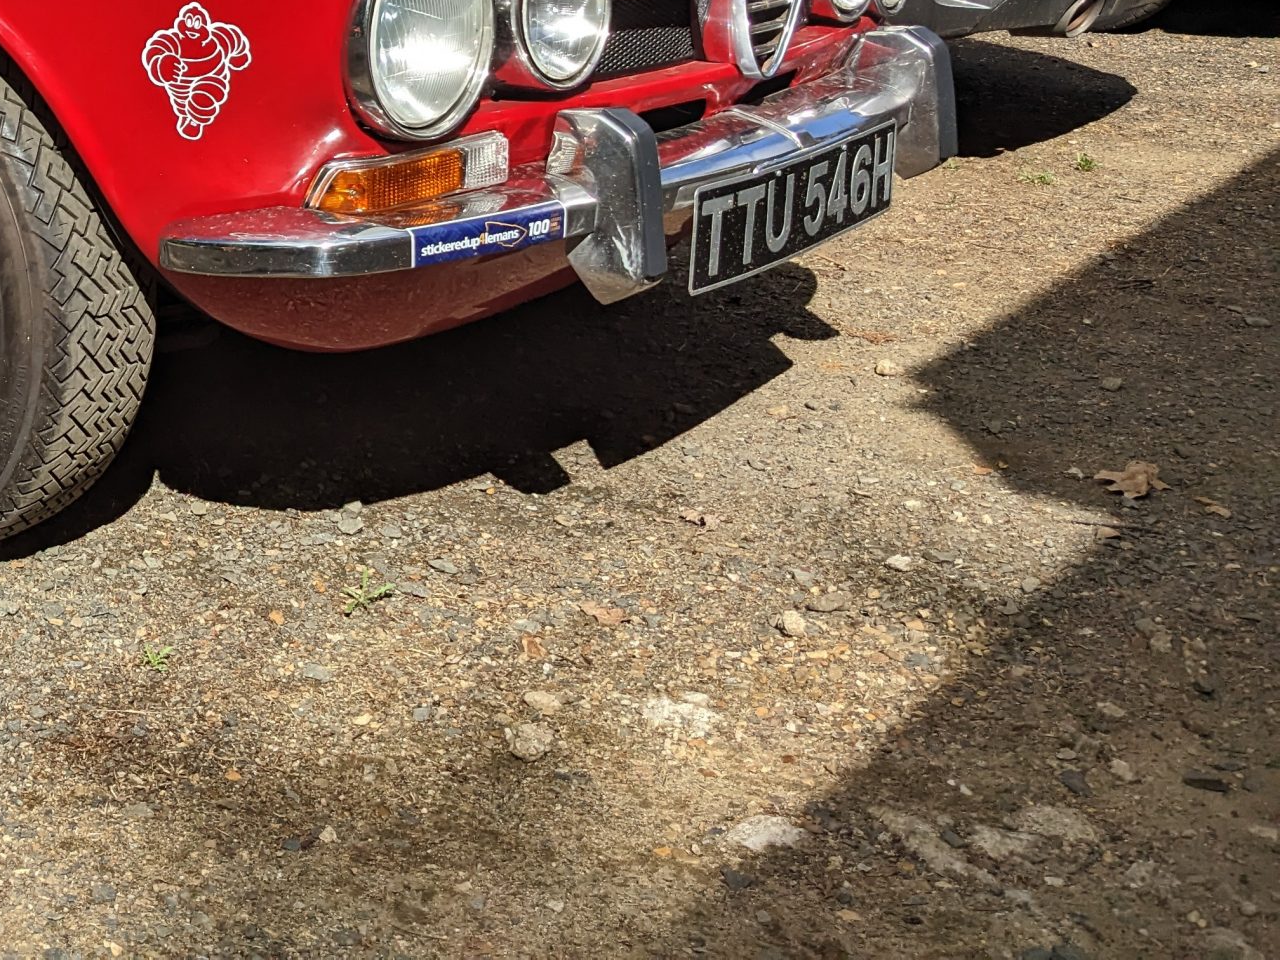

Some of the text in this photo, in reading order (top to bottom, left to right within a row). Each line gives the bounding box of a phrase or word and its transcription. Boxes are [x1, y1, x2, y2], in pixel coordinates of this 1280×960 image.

[420, 229, 520, 257] stickeredup4lemans
[528, 218, 550, 237] 100
[701, 131, 894, 277] TTU 546H
